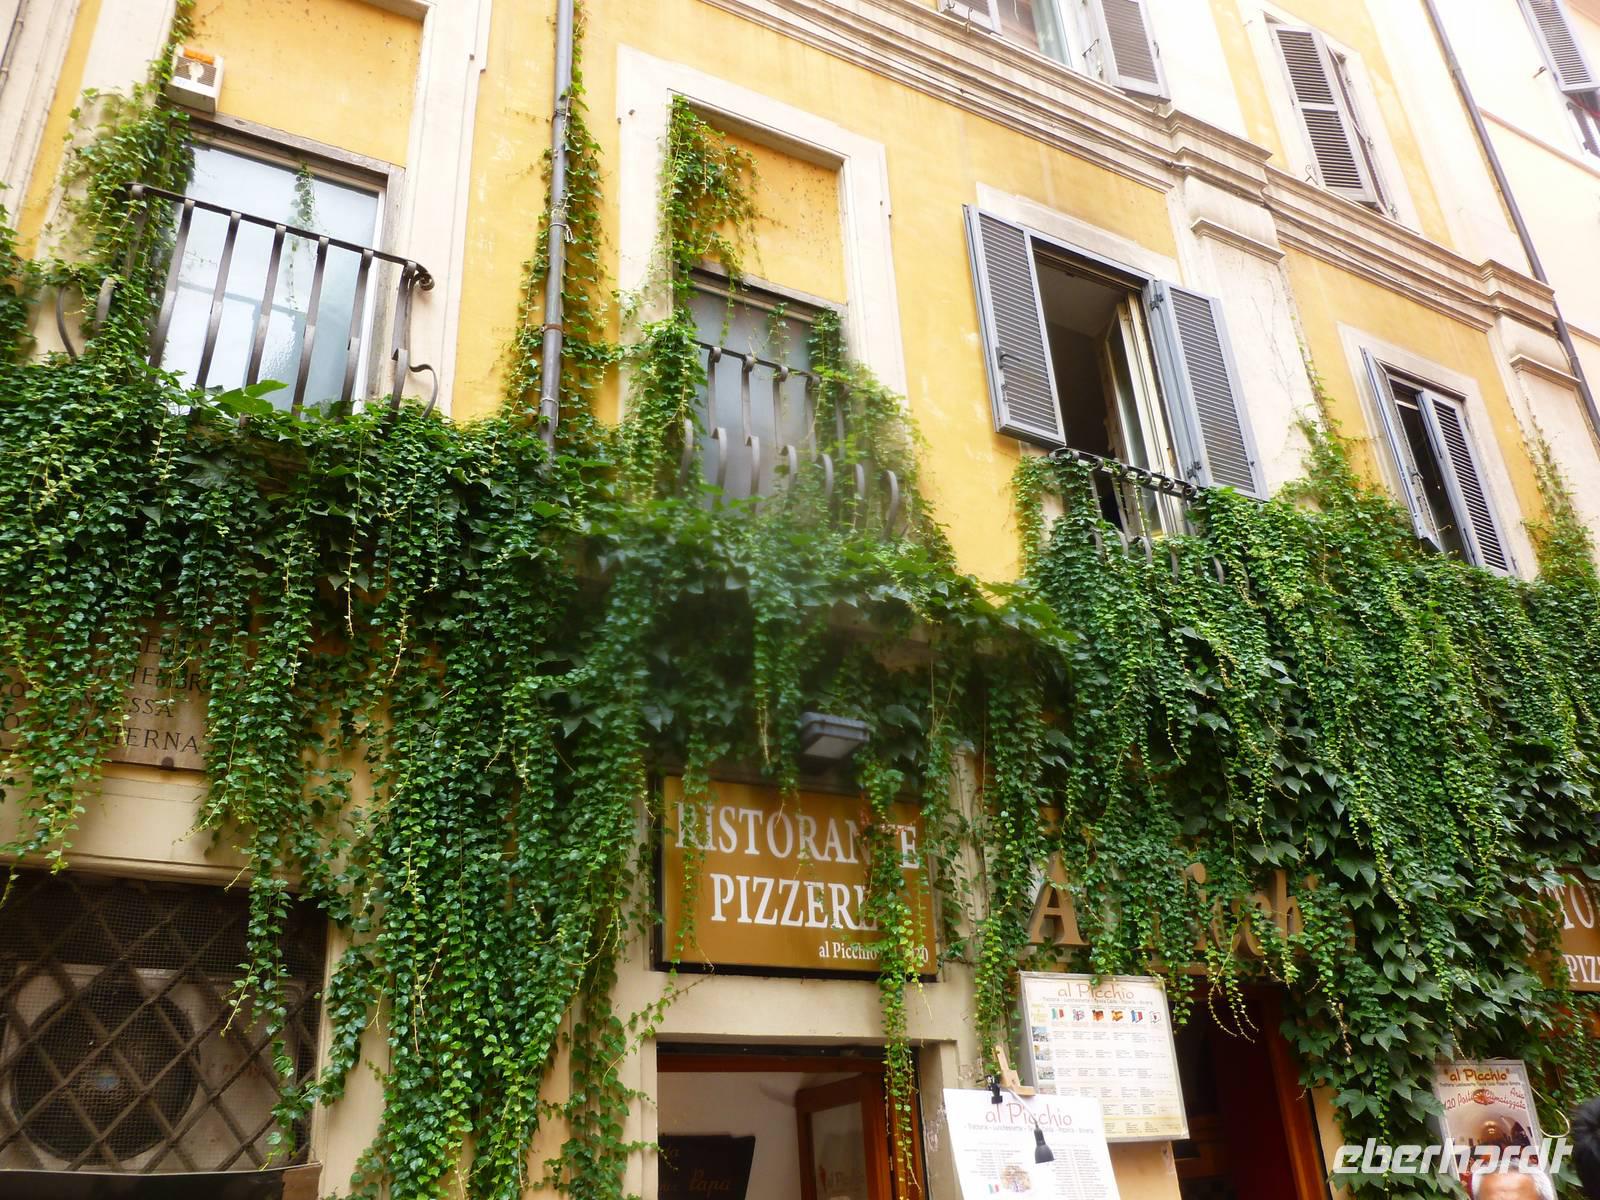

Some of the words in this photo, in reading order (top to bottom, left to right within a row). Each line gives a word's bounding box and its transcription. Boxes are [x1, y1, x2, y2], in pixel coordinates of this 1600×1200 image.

[674, 801, 920, 869] RISTORANE
[709, 873, 881, 931] PIZZERI
[818, 941, 830, 958] al
[1057, 983, 1072, 998] al
[1077, 983, 1135, 1001] Picchio
[985, 1103, 1002, 1124] al
